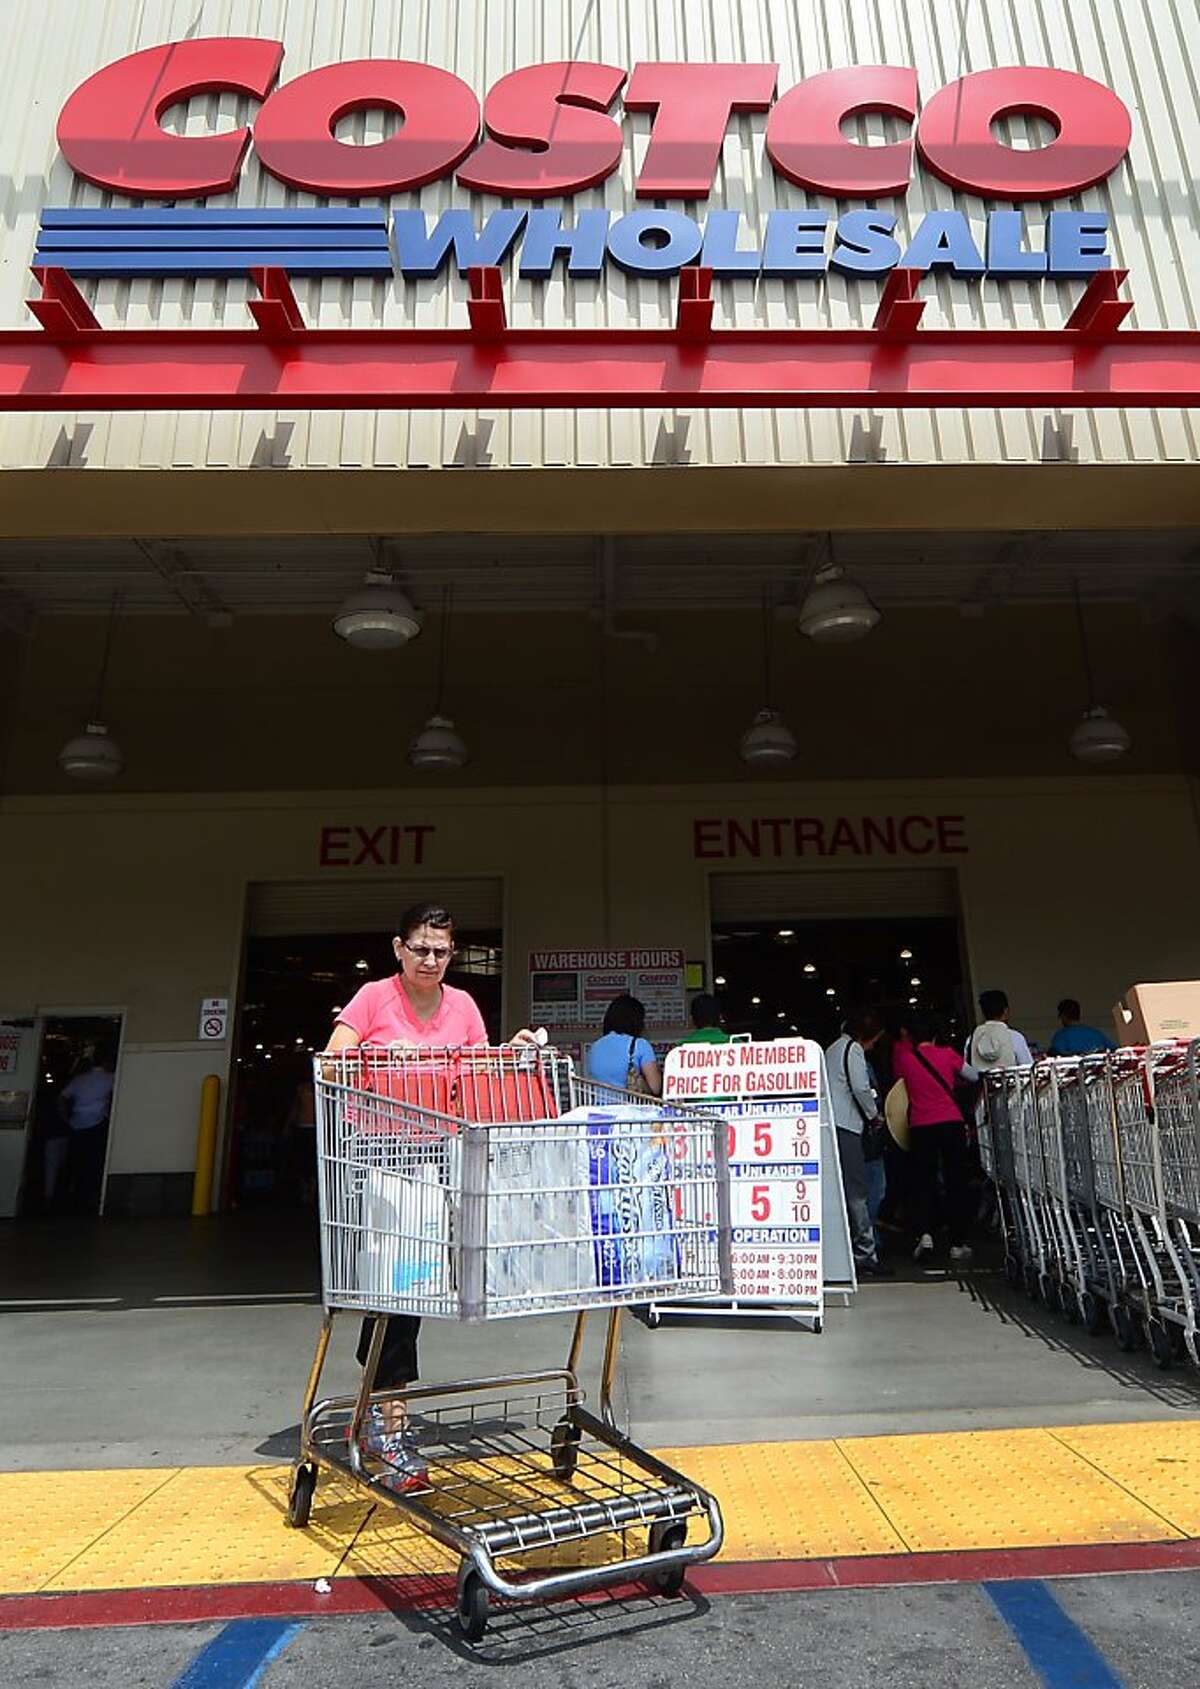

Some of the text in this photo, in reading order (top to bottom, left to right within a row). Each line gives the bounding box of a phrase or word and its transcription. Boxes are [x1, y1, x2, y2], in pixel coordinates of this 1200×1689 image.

[56, 37, 1132, 200] COSTCO
[392, 208, 1112, 280] WHOLESALE
[320, 826, 435, 865] EXIT
[694, 816, 969, 858] ENTRANCE
[534, 950, 680, 969] WAREHOUSE HOURS
[679, 1049, 736, 1068] TODAY'S
[740, 1046, 806, 1065] MEMBER
[666, 1071, 817, 1094] PRICE FOR GASOLINE
[742, 1102, 804, 1115] UNLEADED
[742, 1164, 804, 1178] UNLEADED
[733, 1228, 810, 1243] OPERATION
